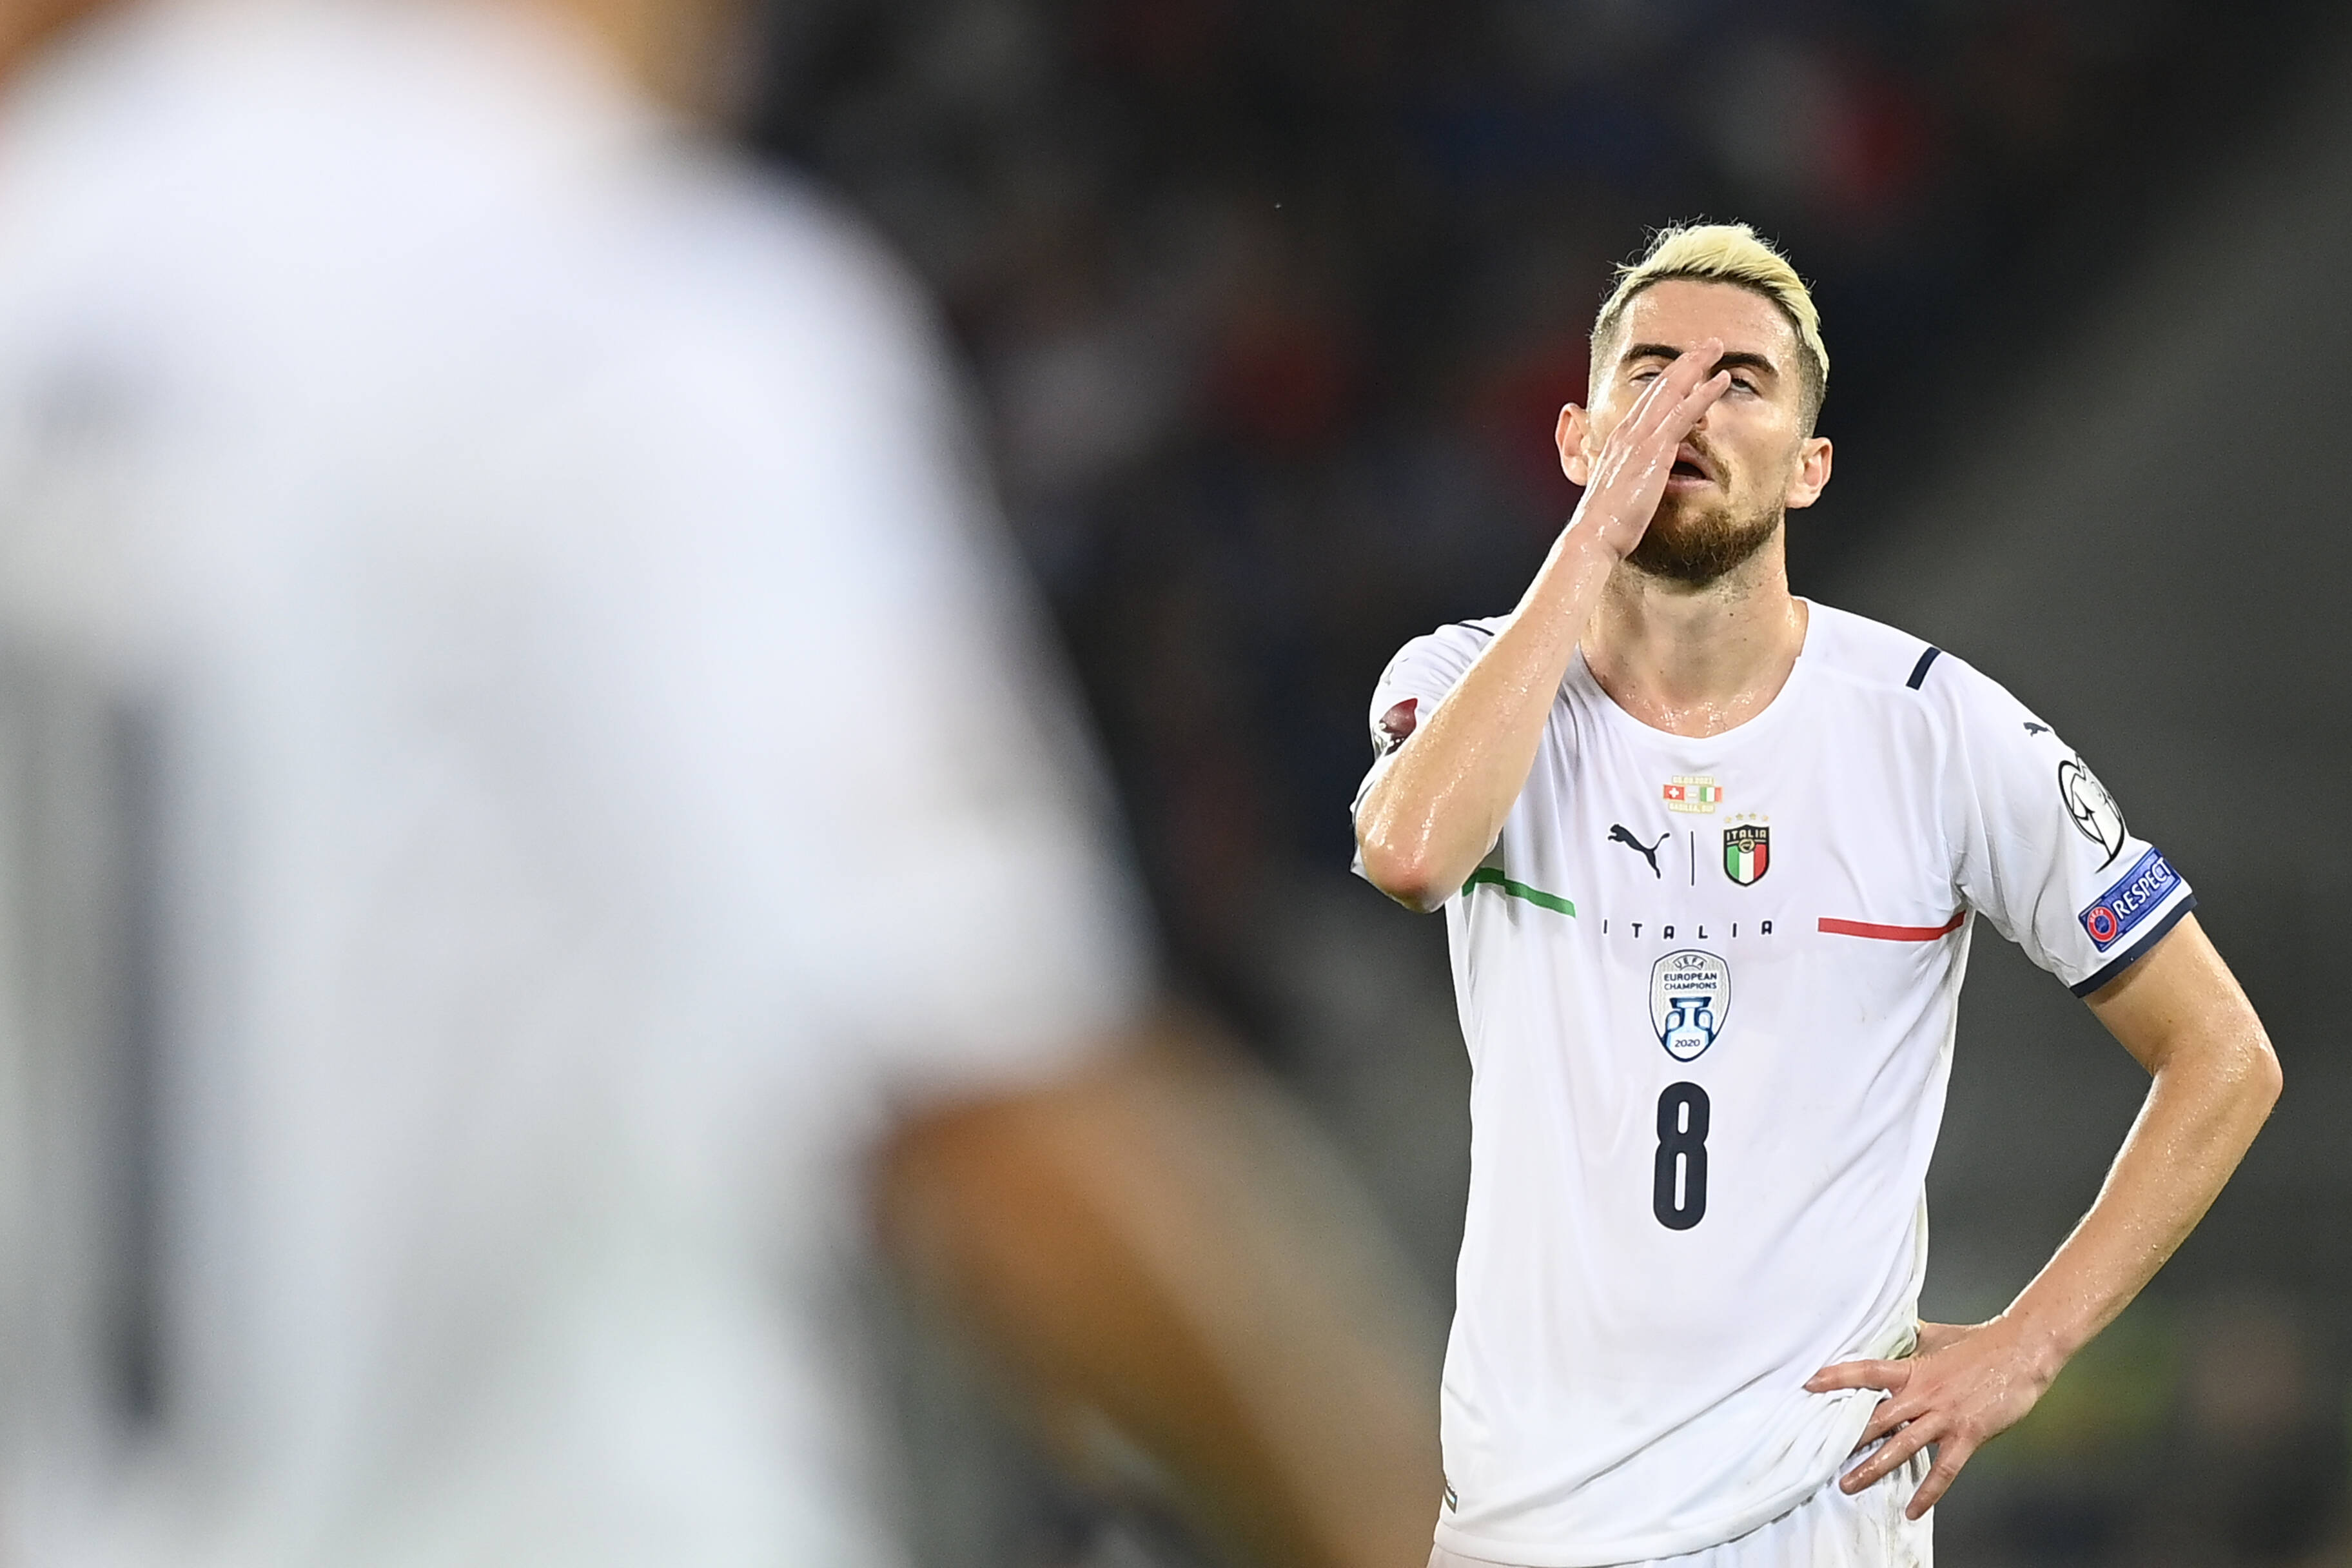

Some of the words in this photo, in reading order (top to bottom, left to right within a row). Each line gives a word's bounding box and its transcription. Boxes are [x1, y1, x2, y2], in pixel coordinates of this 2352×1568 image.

[1727, 829, 1767, 841] ITALIA
[2112, 857, 2171, 919] RESPECT
[1603, 919, 1772, 939] ITALIA
[1674, 957, 1704, 969] UEFA
[1663, 972, 1717, 981] EUROPEAN
[1663, 982, 1717, 990] CHAMPIONS
[1674, 1039, 1700, 1047] 2020
[1653, 1081, 1710, 1231] 8
